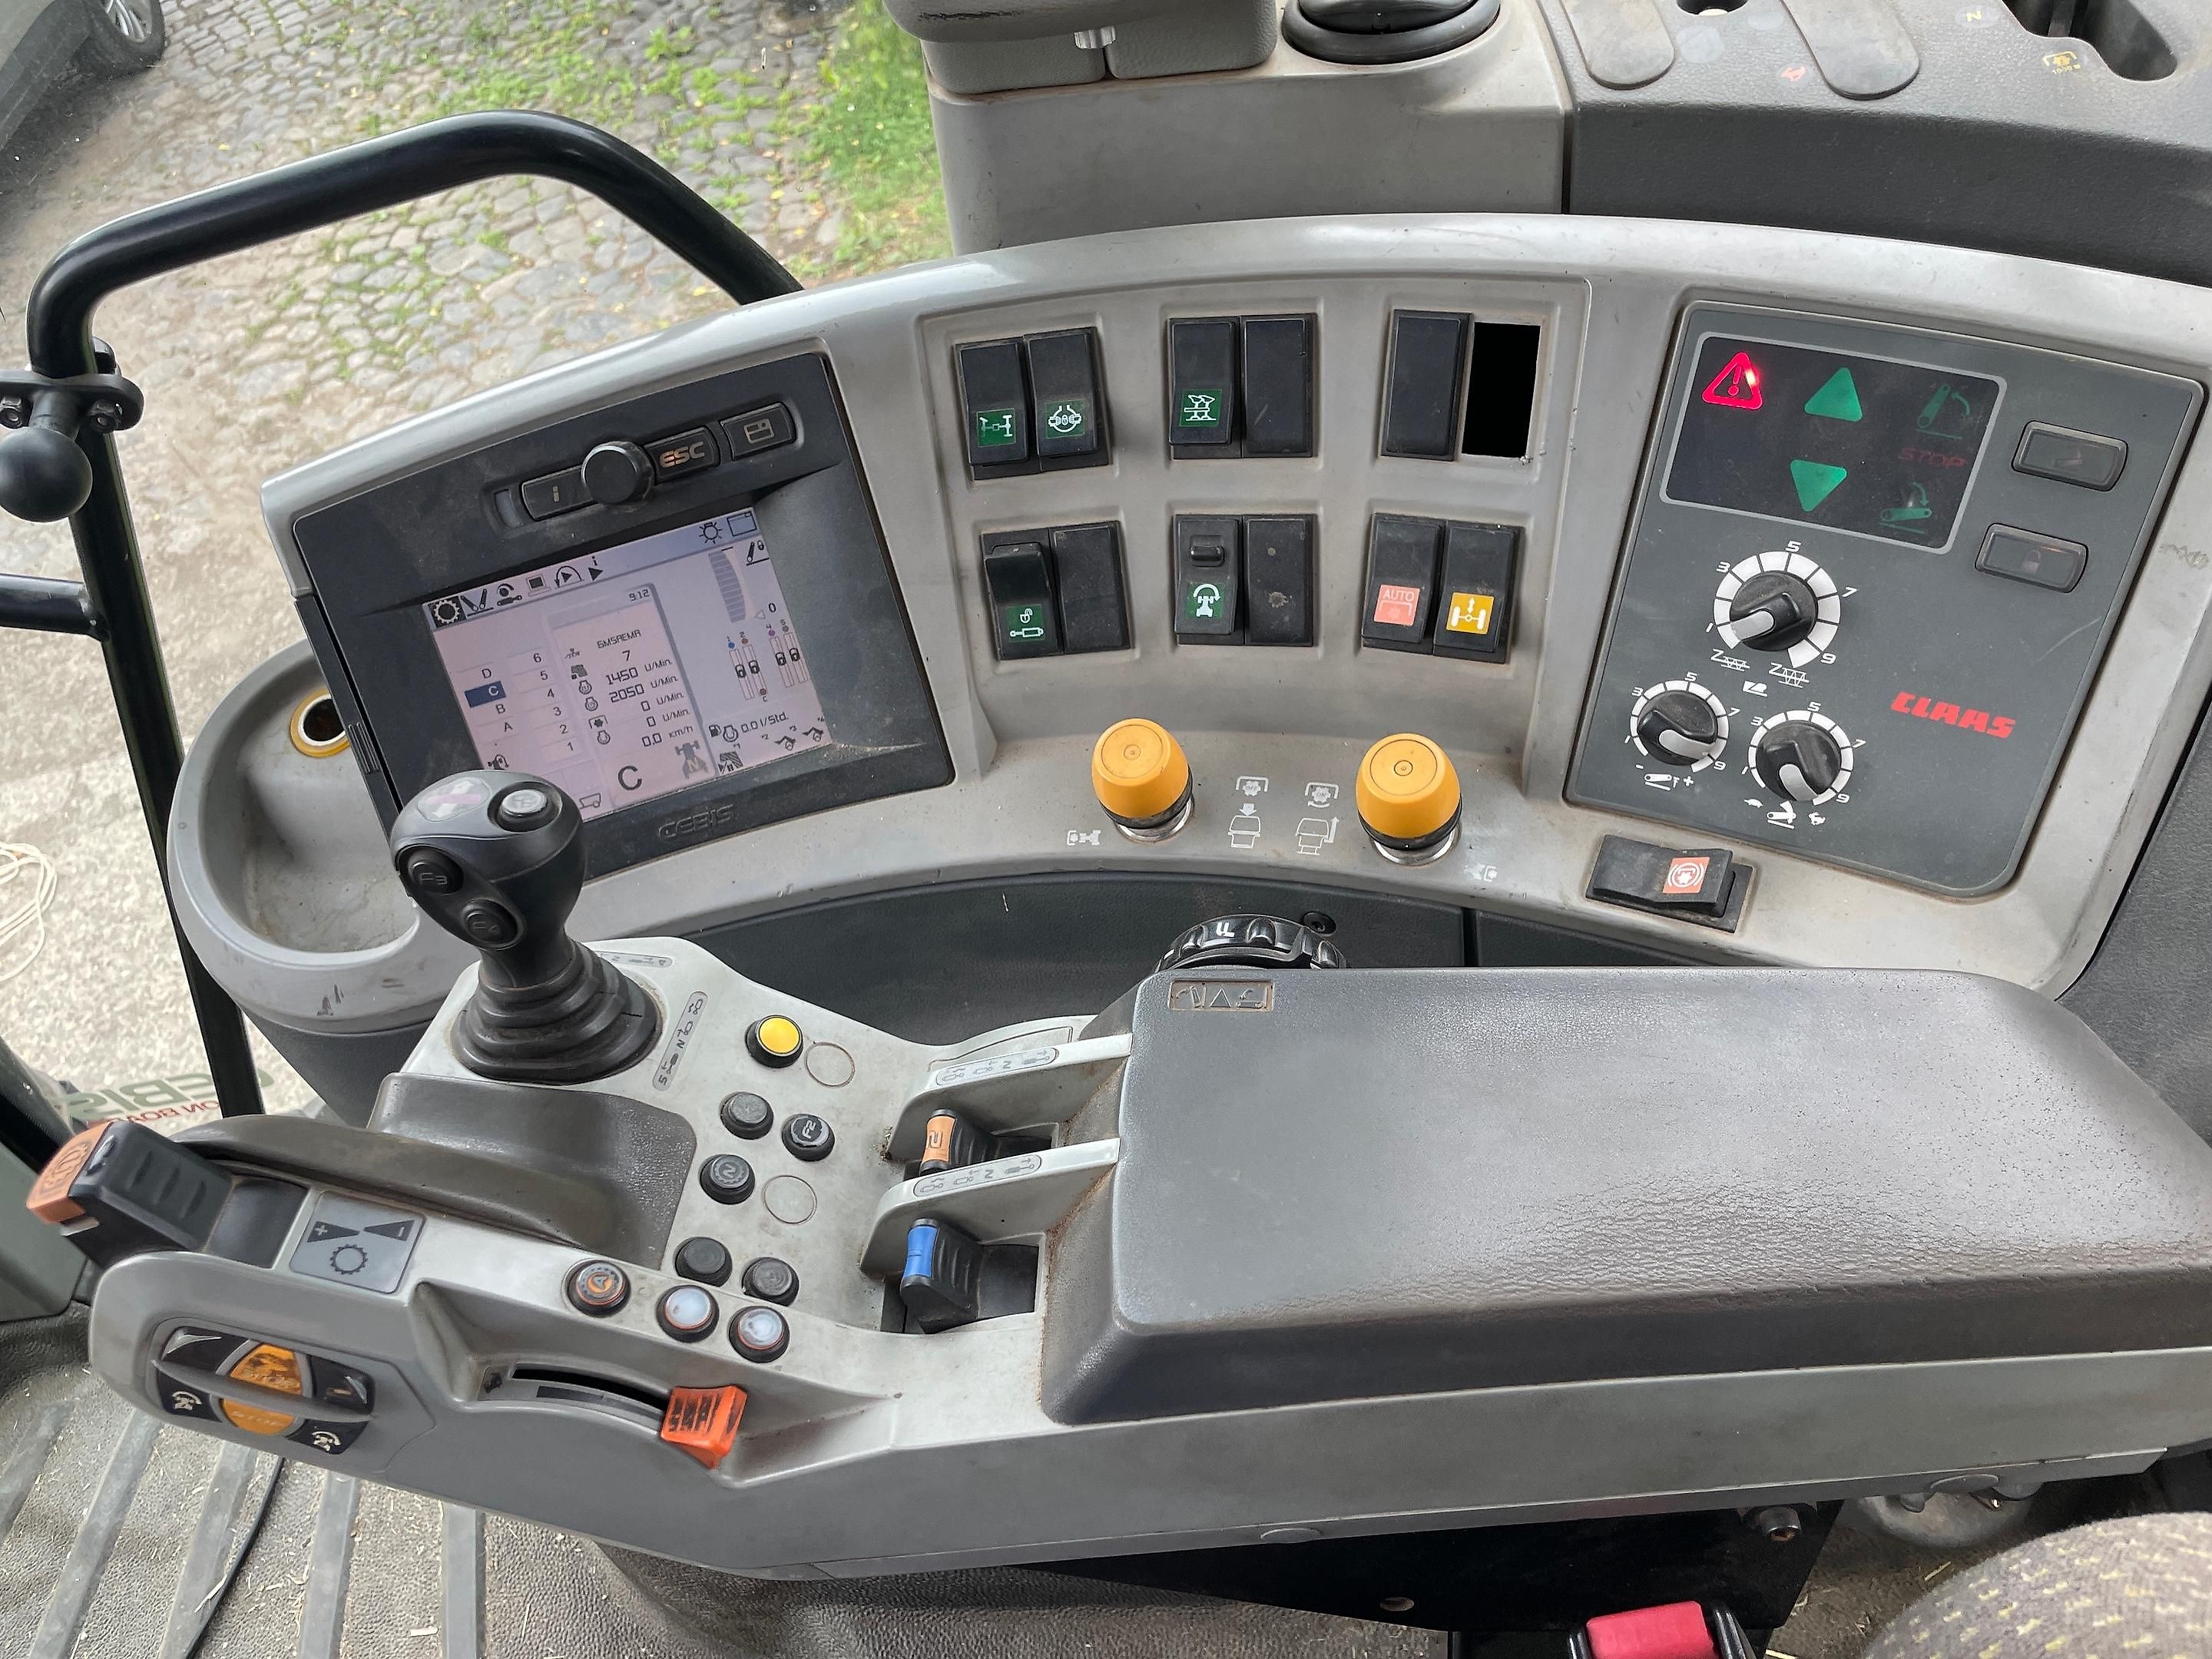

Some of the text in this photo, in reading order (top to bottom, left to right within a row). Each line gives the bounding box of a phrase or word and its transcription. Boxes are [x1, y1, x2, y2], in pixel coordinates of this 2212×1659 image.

[659, 442, 705, 468] ESC
[1898, 447, 1967, 469] STOP
[1785, 541, 1801, 553] 5
[1717, 561, 1730, 573] 3
[629, 589, 650, 601] 9:12
[1382, 589, 1415, 601] AUTO
[1842, 587, 1858, 598] 7
[768, 602, 777, 613] 0
[1705, 622, 1714, 633] 1
[533, 653, 541, 663] 6
[622, 650, 631, 661] 7
[1820, 653, 1836, 664] 9
[482, 668, 492, 679] D
[540, 671, 548, 680] 5
[605, 667, 638, 685] 1450
[1684, 671, 1698, 682] 5
[488, 685, 499, 696] C
[547, 688, 555, 697] 4
[609, 684, 644, 703] 2050
[1631, 687, 1644, 697] 3
[495, 704, 506, 714] B
[641, 700, 651, 711] 0
[1807, 701, 1821, 712] 5
[553, 707, 561, 716] 3
[1727, 707, 1740, 717] 7
[1890, 690, 2016, 739] CLAAS
[504, 722, 513, 732] A
[646, 717, 656, 727] 0
[741, 721, 758, 733] 0.0
[1750, 716, 1764, 727] 3
[560, 724, 568, 734] 2
[641, 725, 694, 747] 0.0 km/h
[1624, 735, 1631, 743] 1
[568, 742, 574, 752] 1
[1853, 739, 1866, 749] 7
[1714, 760, 1727, 771] 9
[1741, 766, 1749, 775] 1
[618, 765, 642, 790] C
[1836, 793, 1849, 804] 9
[658, 804, 733, 839] CEBIS
[802, 1120, 816, 1138] F2
[723, 1164, 737, 1178] N
